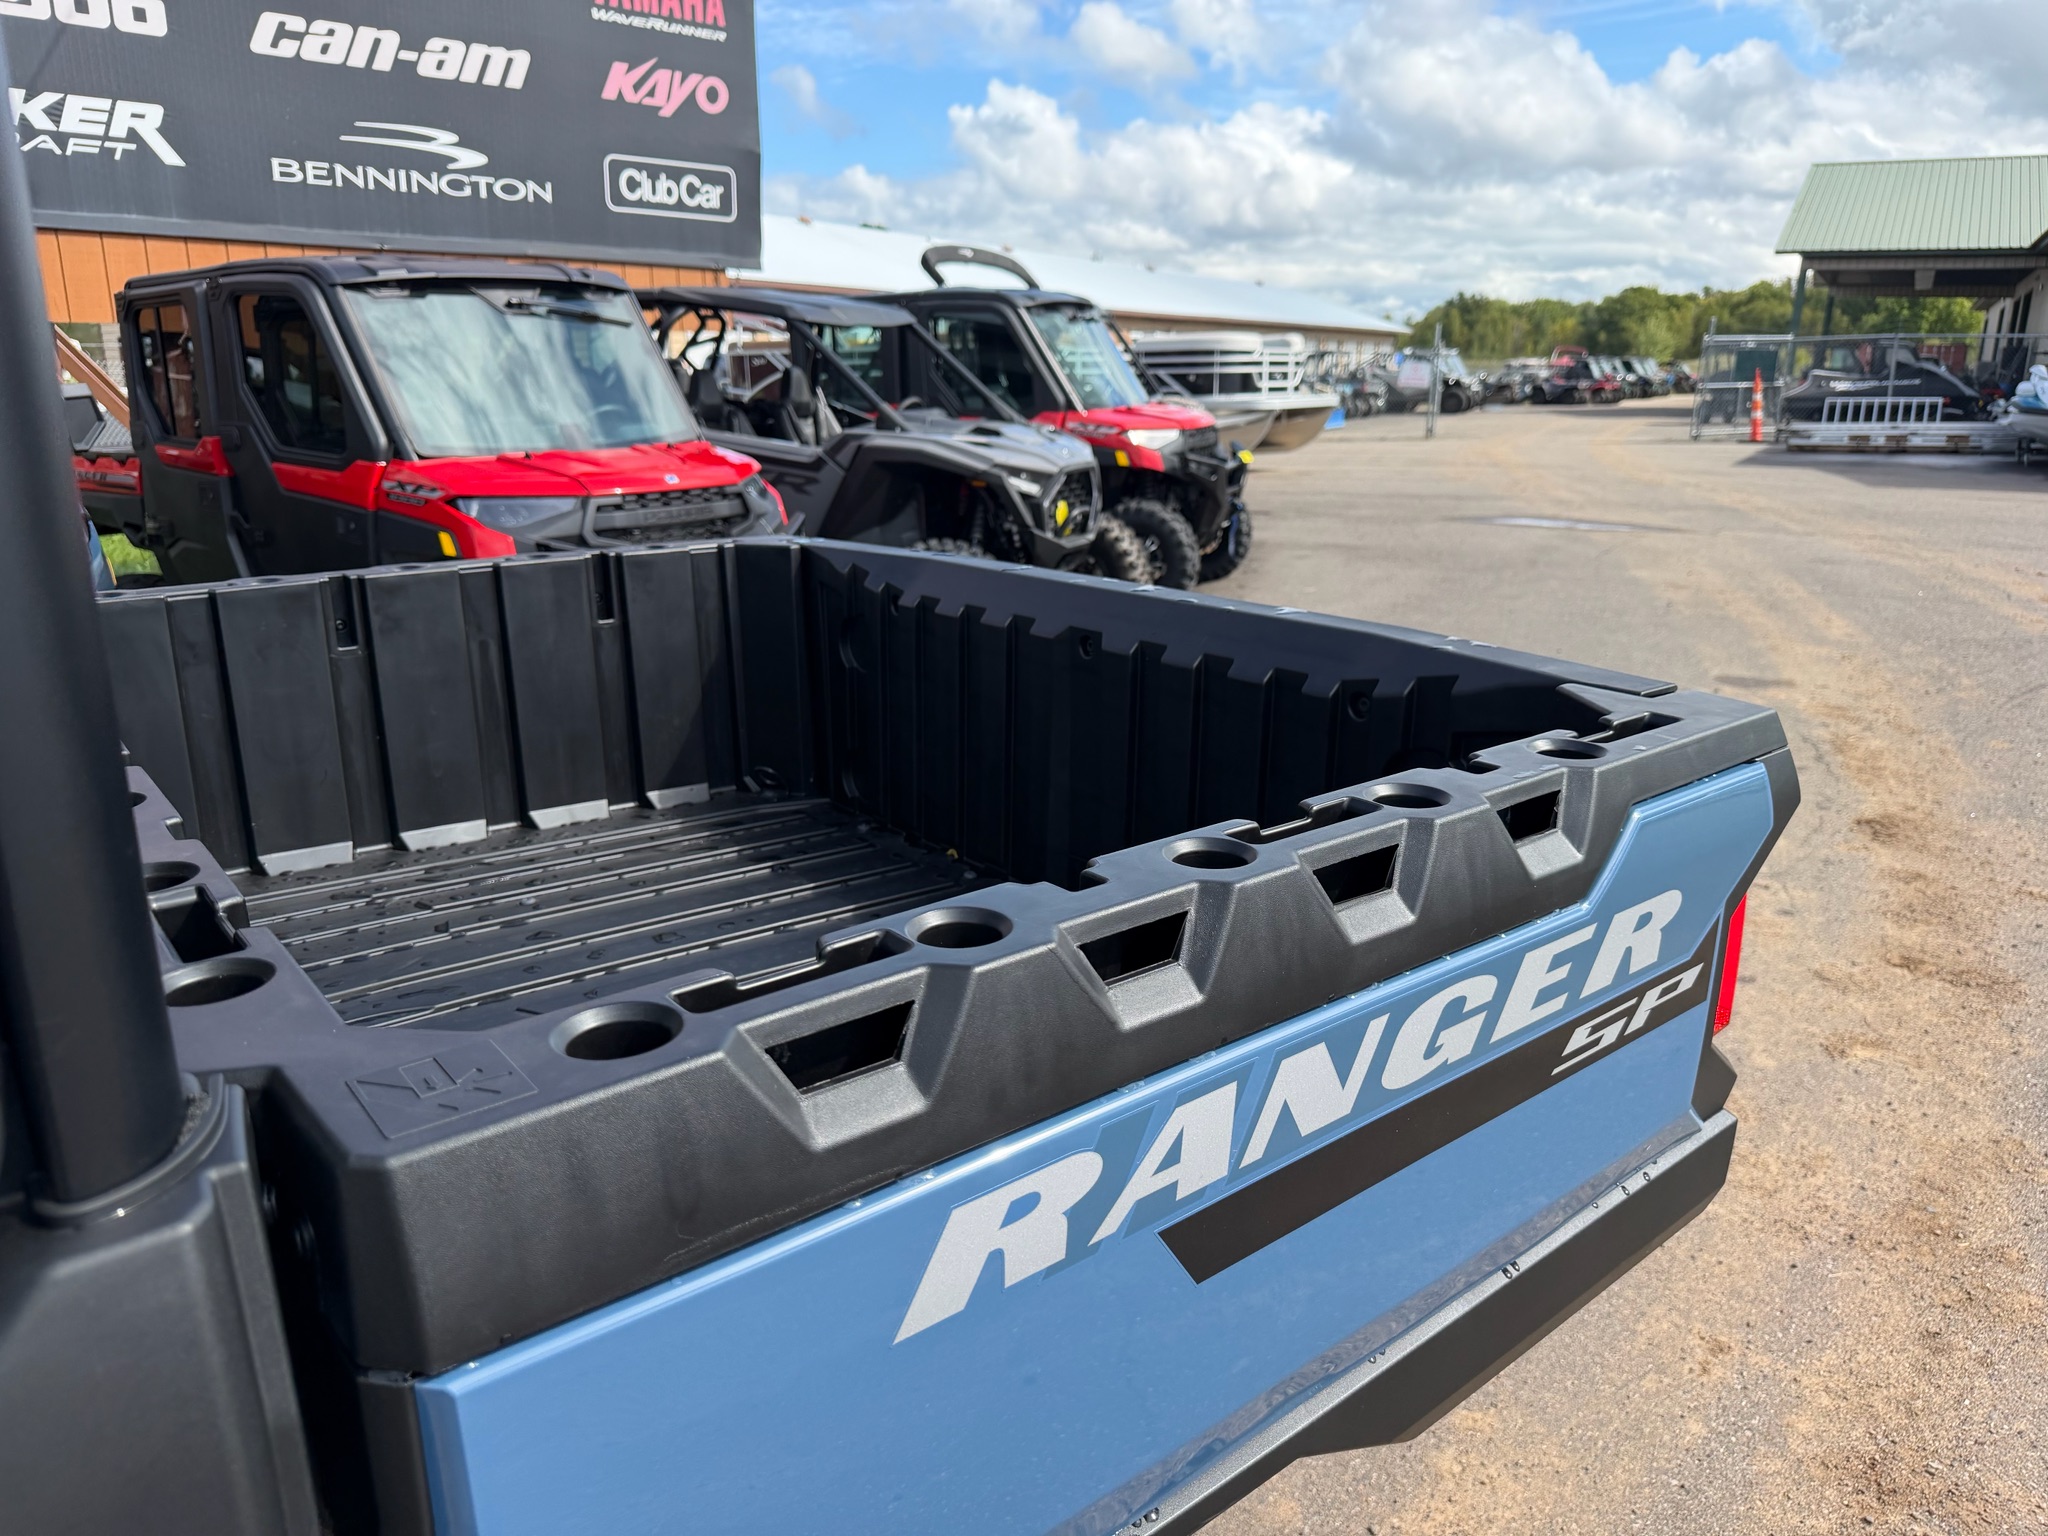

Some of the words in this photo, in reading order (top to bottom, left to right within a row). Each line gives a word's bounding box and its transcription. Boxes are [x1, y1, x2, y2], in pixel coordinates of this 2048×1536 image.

[250, 11, 531, 90] can-am
[14, 131, 137, 161] AFT
[269, 156, 553, 204] BENNINGTON
[1550, 961, 1705, 1077] SP
[893, 889, 1683, 1345] RANGER
